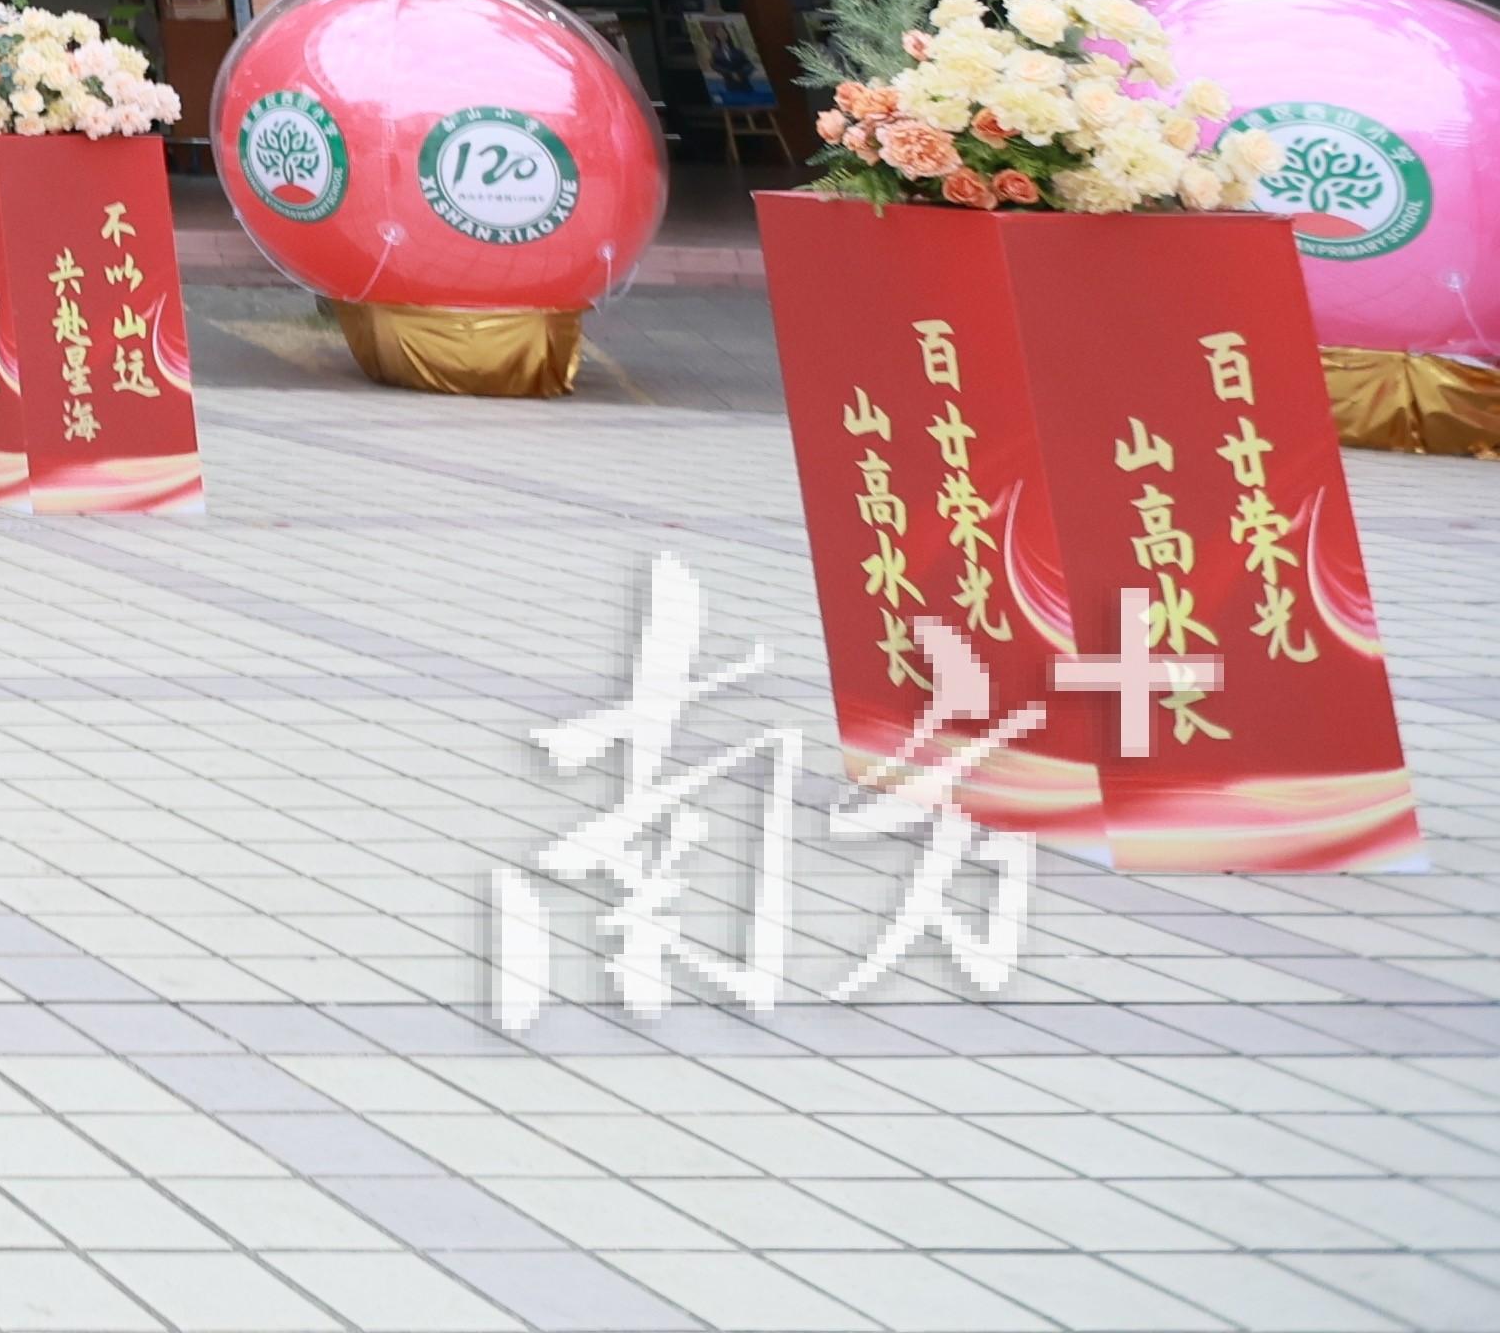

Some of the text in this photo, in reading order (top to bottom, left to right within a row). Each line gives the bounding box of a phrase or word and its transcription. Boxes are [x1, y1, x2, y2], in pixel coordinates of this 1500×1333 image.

[452, 141, 539, 190] 120
[1380, 199, 1425, 245] SCHOOL
[47, 246, 102, 443] 共赴星海
[100, 200, 161, 399] 不以山远
[842, 385, 938, 694] 山高水长
[910, 318, 1014, 642] 百廿荣光
[1112, 416, 1234, 746] 山高水长
[1198, 331, 1320, 663] 百廿荣光
